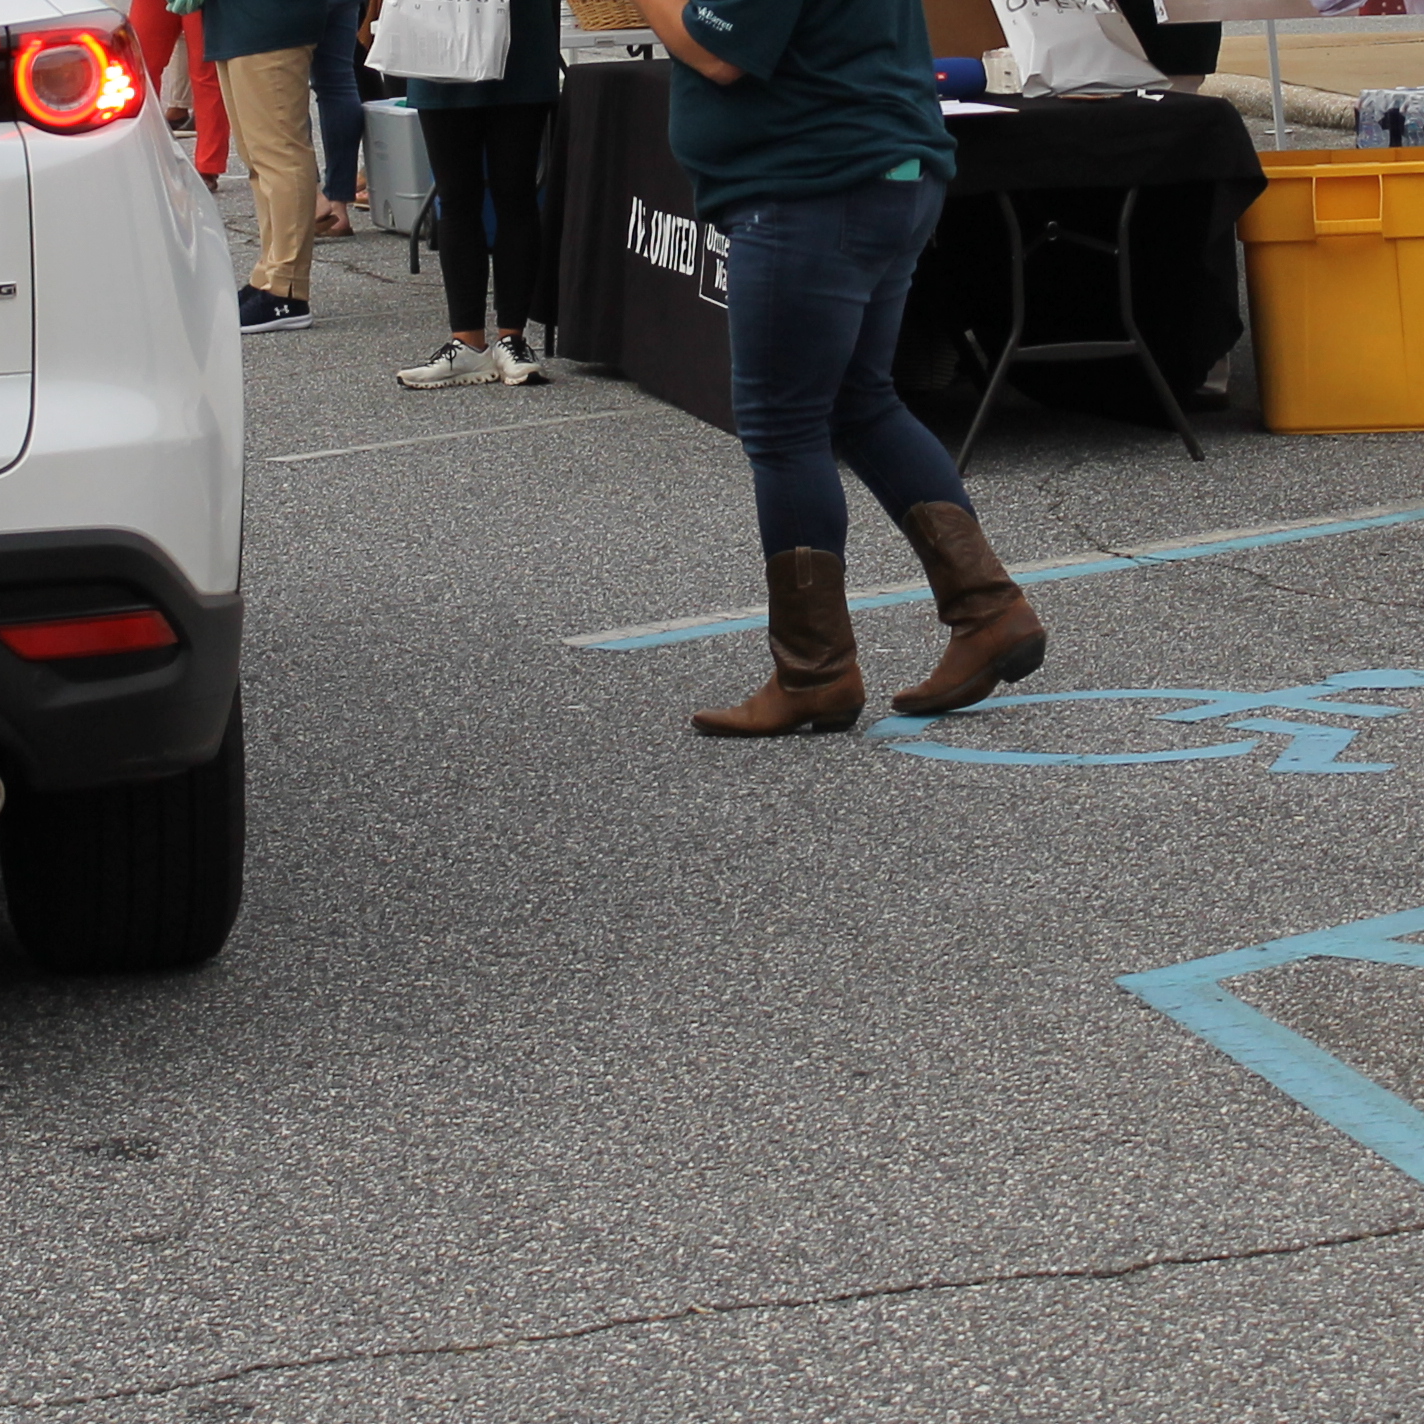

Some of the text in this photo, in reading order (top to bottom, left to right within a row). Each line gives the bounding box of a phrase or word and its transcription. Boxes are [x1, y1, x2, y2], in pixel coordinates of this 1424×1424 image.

[649, 210, 697, 276] UNITED
[706, 223, 731, 258] Unite
[714, 258, 728, 292] Wa
